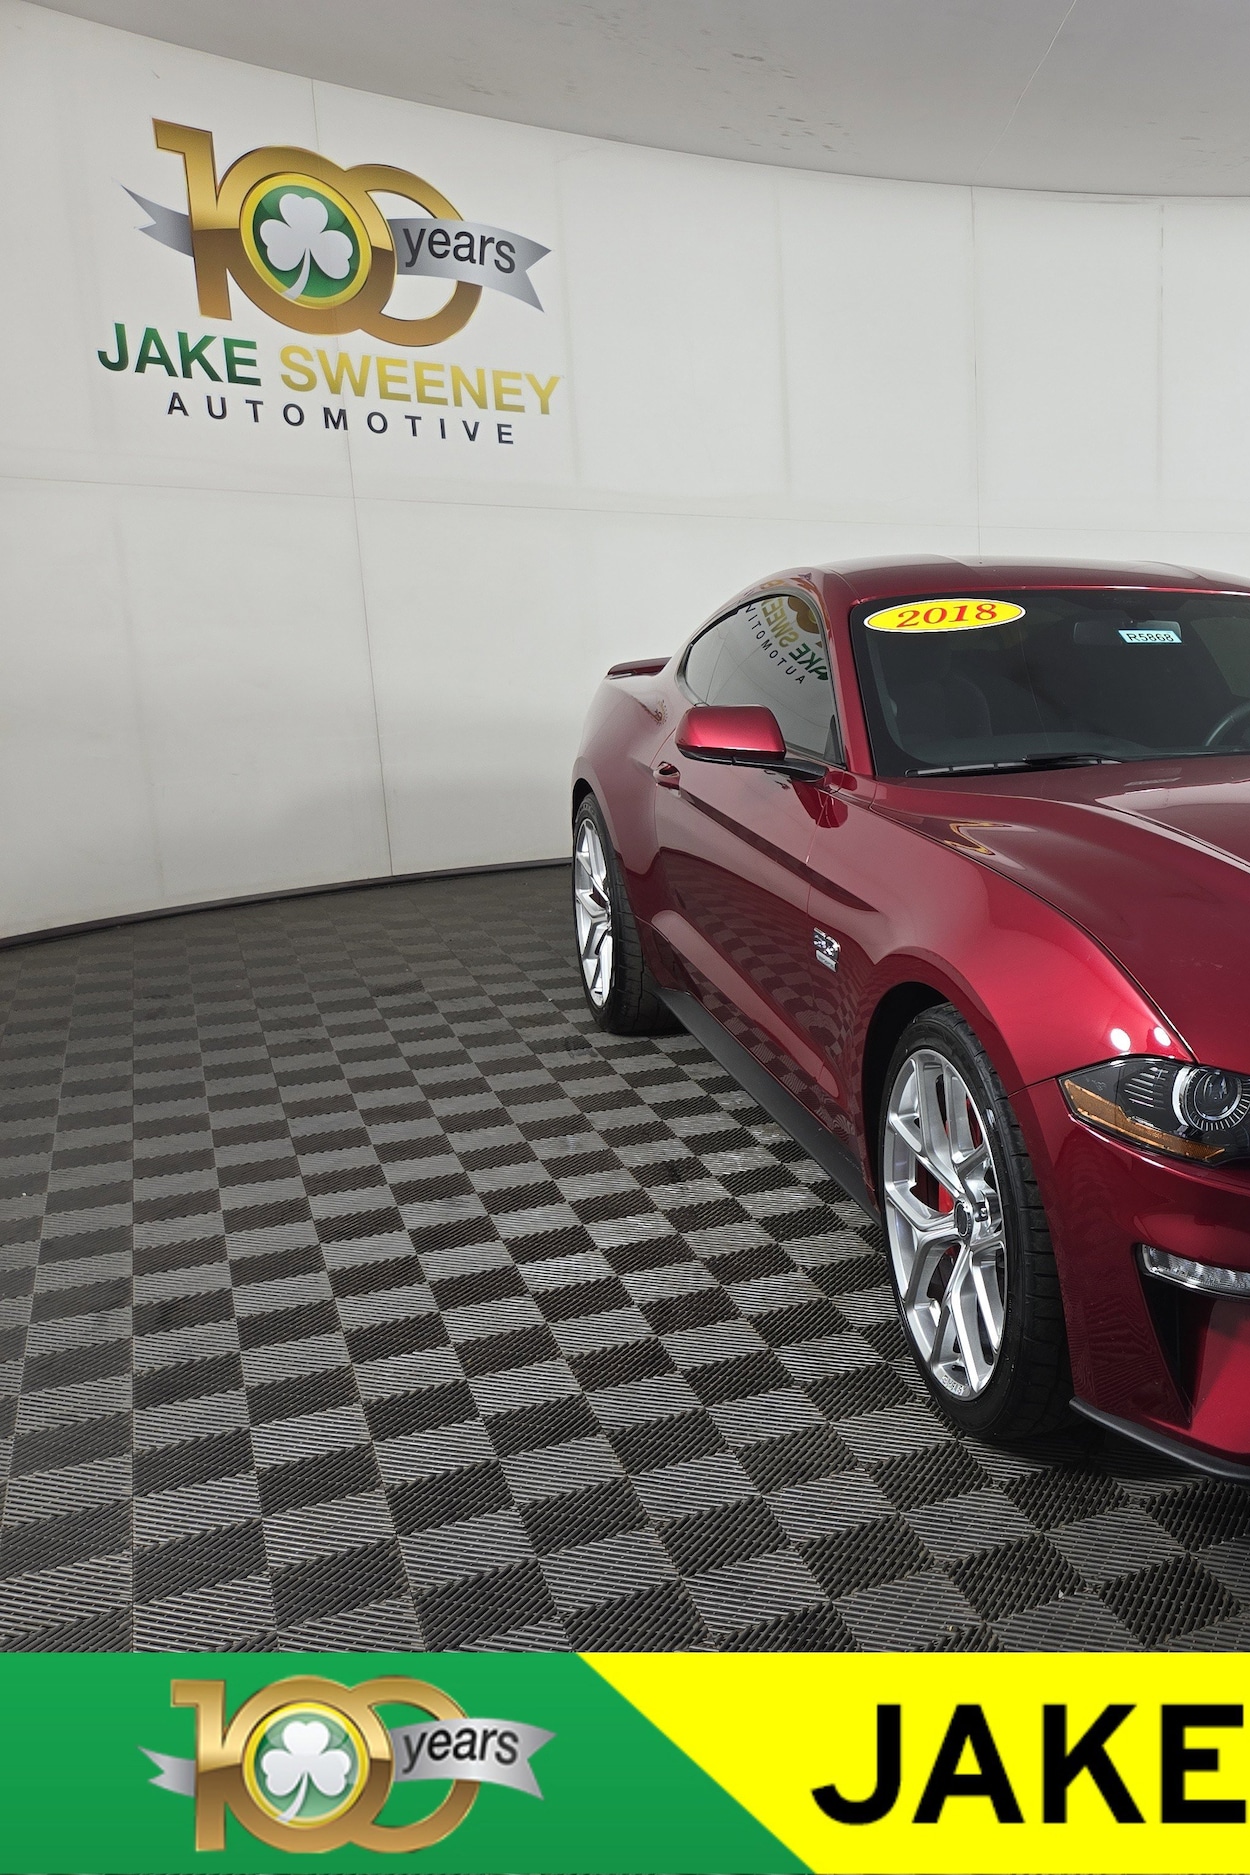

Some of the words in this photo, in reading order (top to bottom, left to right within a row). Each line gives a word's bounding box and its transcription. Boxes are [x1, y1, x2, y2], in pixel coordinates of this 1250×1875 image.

[152, 118, 482, 347] 100
[402, 222, 517, 274] years
[98, 322, 261, 386] JAKE
[280, 345, 560, 415] SWEENEY
[167, 391, 514, 445] AUTOMOTIVE
[896, 603, 997, 628] 2018
